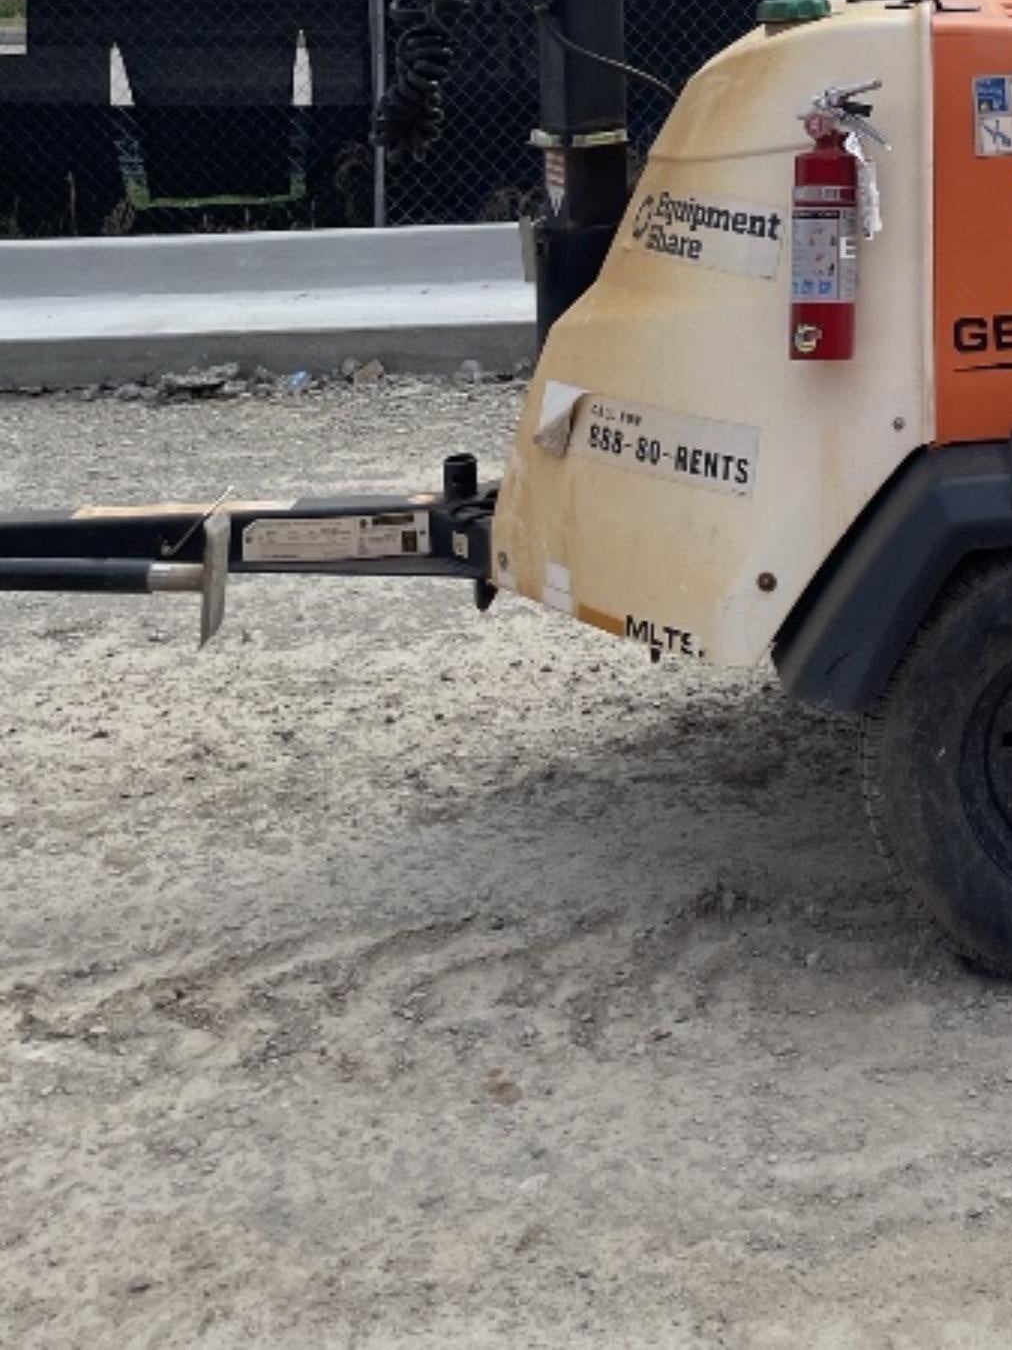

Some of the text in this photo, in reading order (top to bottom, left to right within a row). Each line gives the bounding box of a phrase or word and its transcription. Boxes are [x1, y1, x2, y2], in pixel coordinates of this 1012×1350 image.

[655, 191, 781, 240] Equipment
[646, 224, 703, 259] Share
[588, 423, 750, 485] 888-80-RENTS
